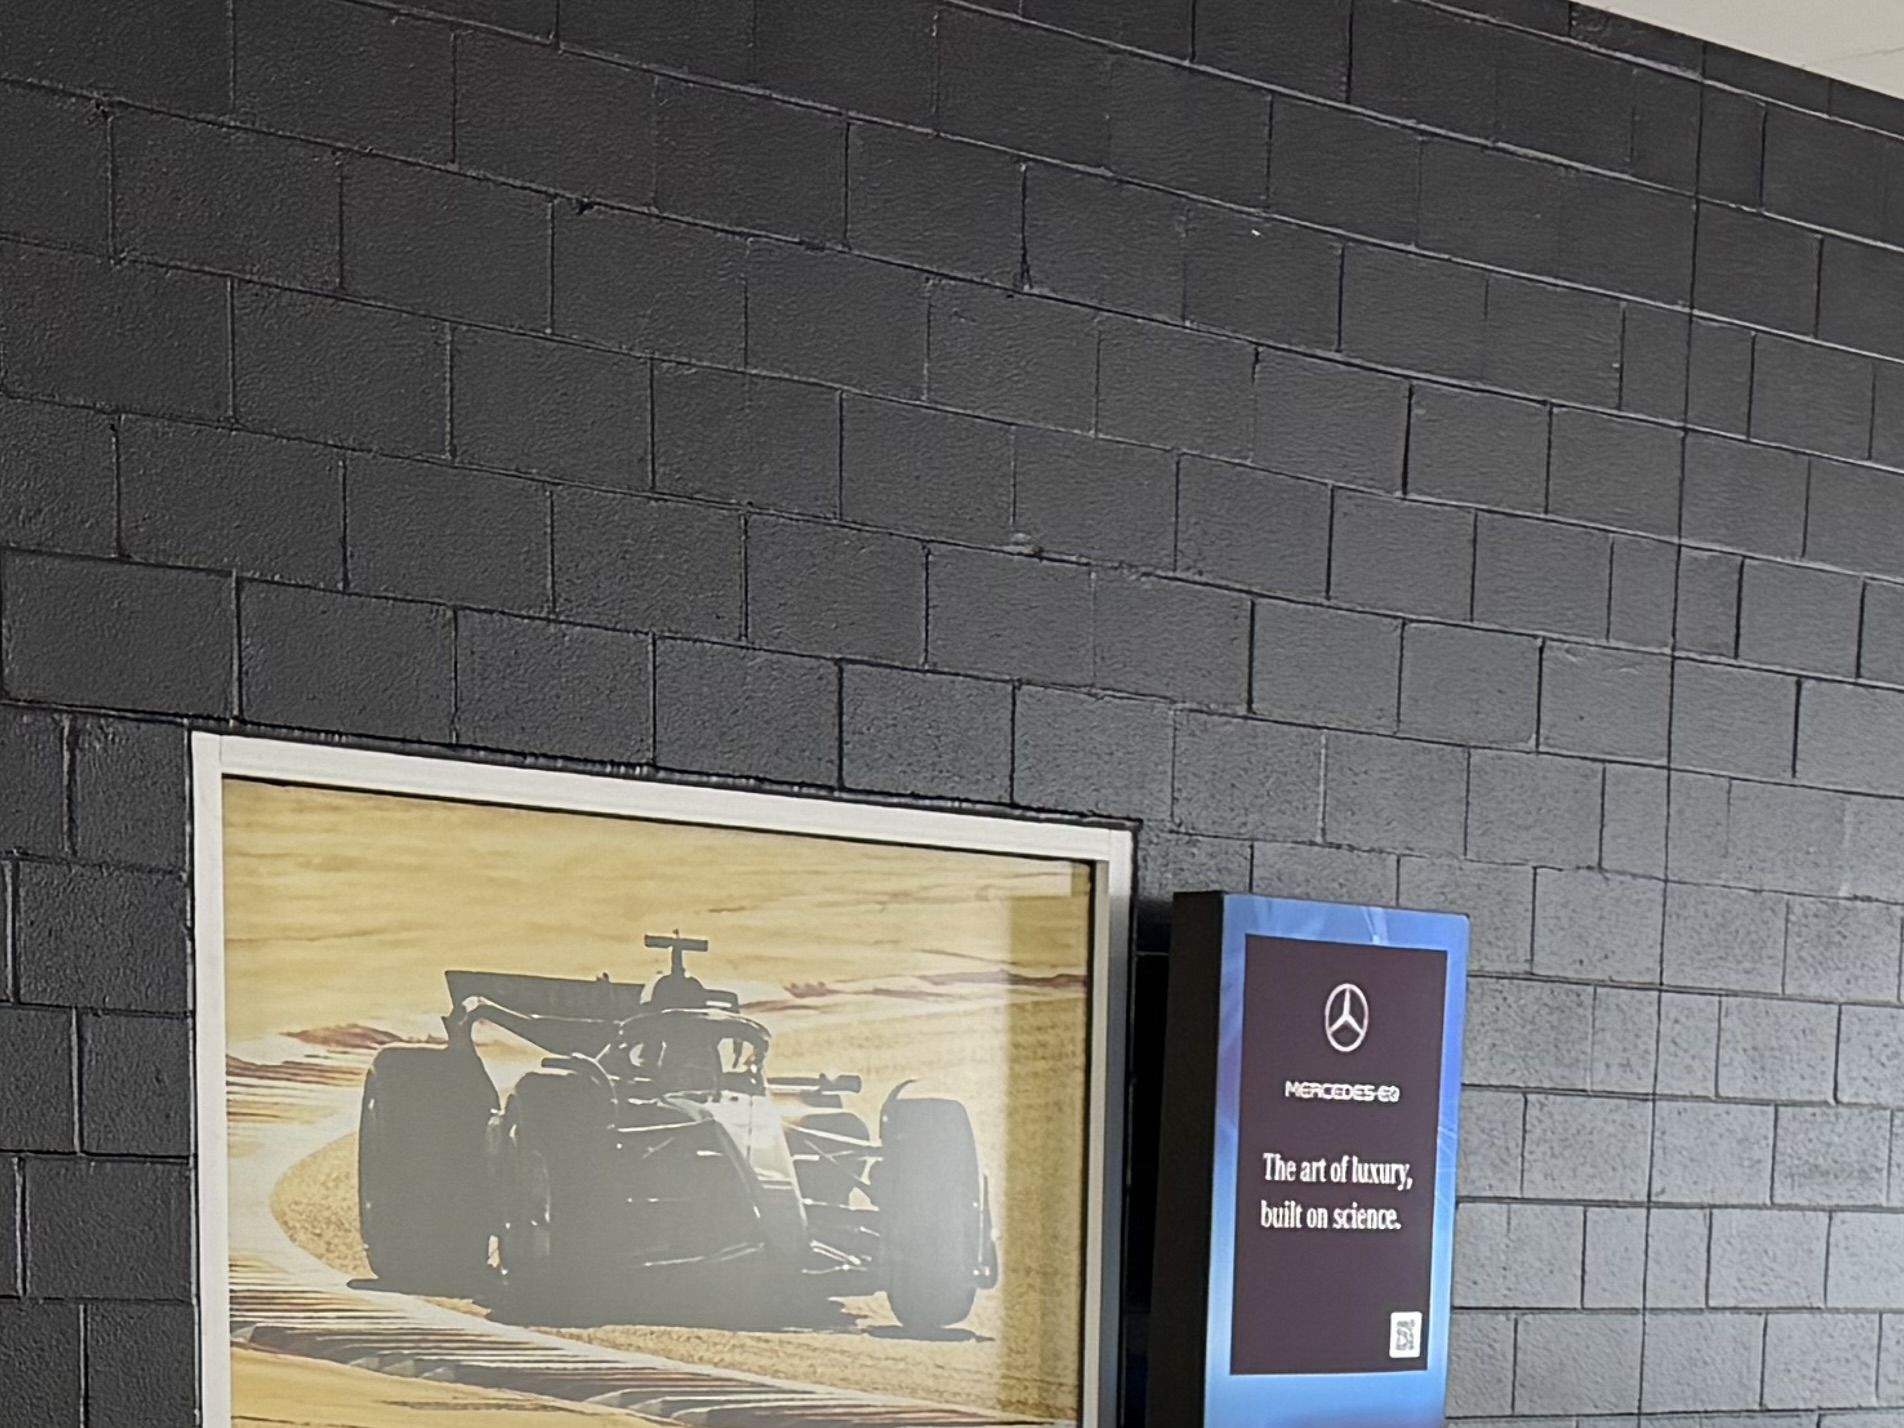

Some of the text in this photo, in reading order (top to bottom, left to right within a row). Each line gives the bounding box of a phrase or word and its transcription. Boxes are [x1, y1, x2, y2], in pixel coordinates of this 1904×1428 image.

[1284, 1080, 1401, 1103] MERCEDES-EQ
[1262, 1152, 1414, 1191] The art of luxury,
[1260, 1199, 1402, 1230] built on science.
